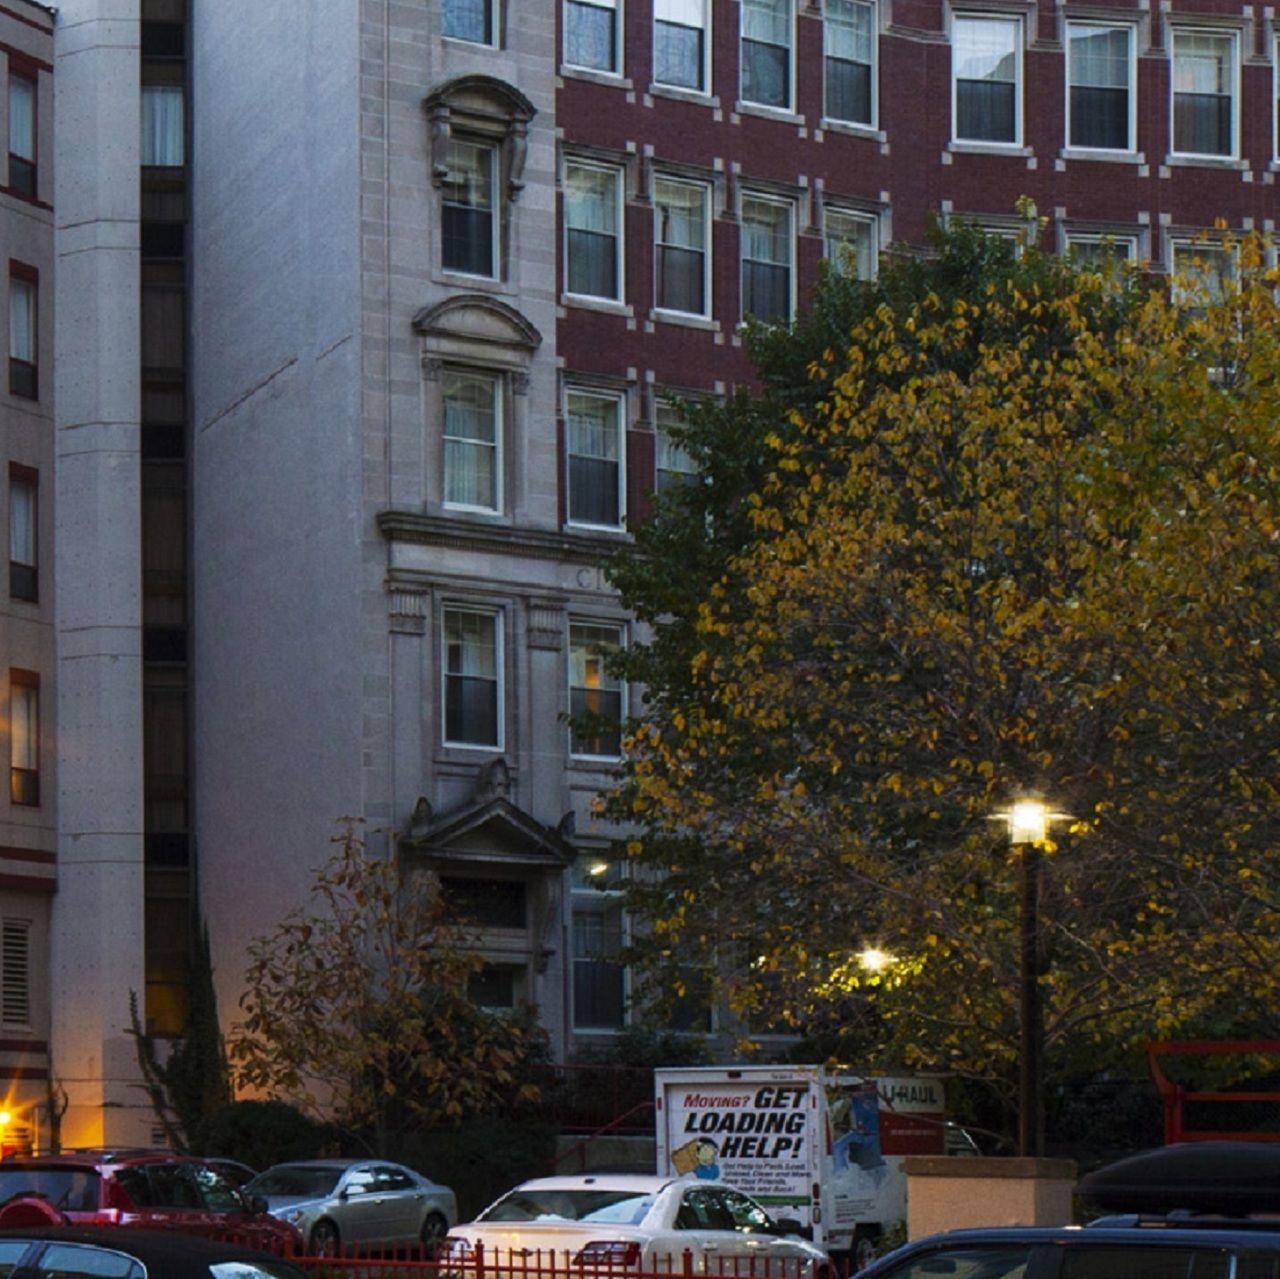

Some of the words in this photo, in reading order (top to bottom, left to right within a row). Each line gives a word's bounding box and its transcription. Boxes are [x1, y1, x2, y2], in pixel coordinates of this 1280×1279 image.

[754, 1087, 808, 1109] GET
[684, 1112, 805, 1134] LOADING
[719, 1137, 803, 1158] HELP!
